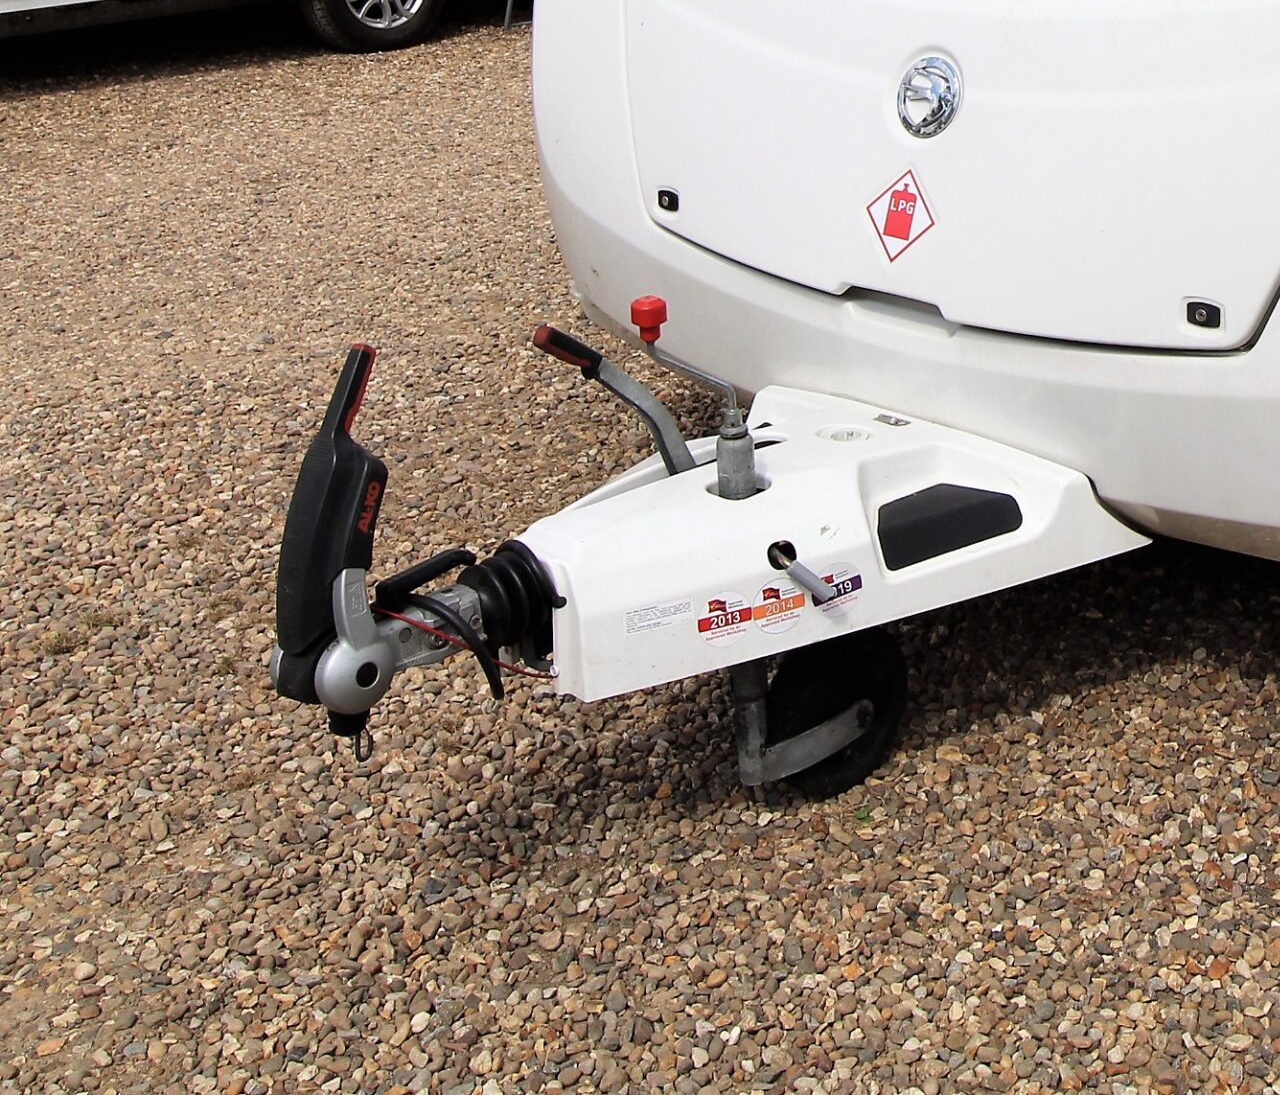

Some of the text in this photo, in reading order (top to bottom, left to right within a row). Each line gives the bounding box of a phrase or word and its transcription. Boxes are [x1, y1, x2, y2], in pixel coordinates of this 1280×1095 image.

[889, 197, 915, 215] LPG
[765, 598, 794, 616] 2014
[710, 611, 741, 629] 2013
